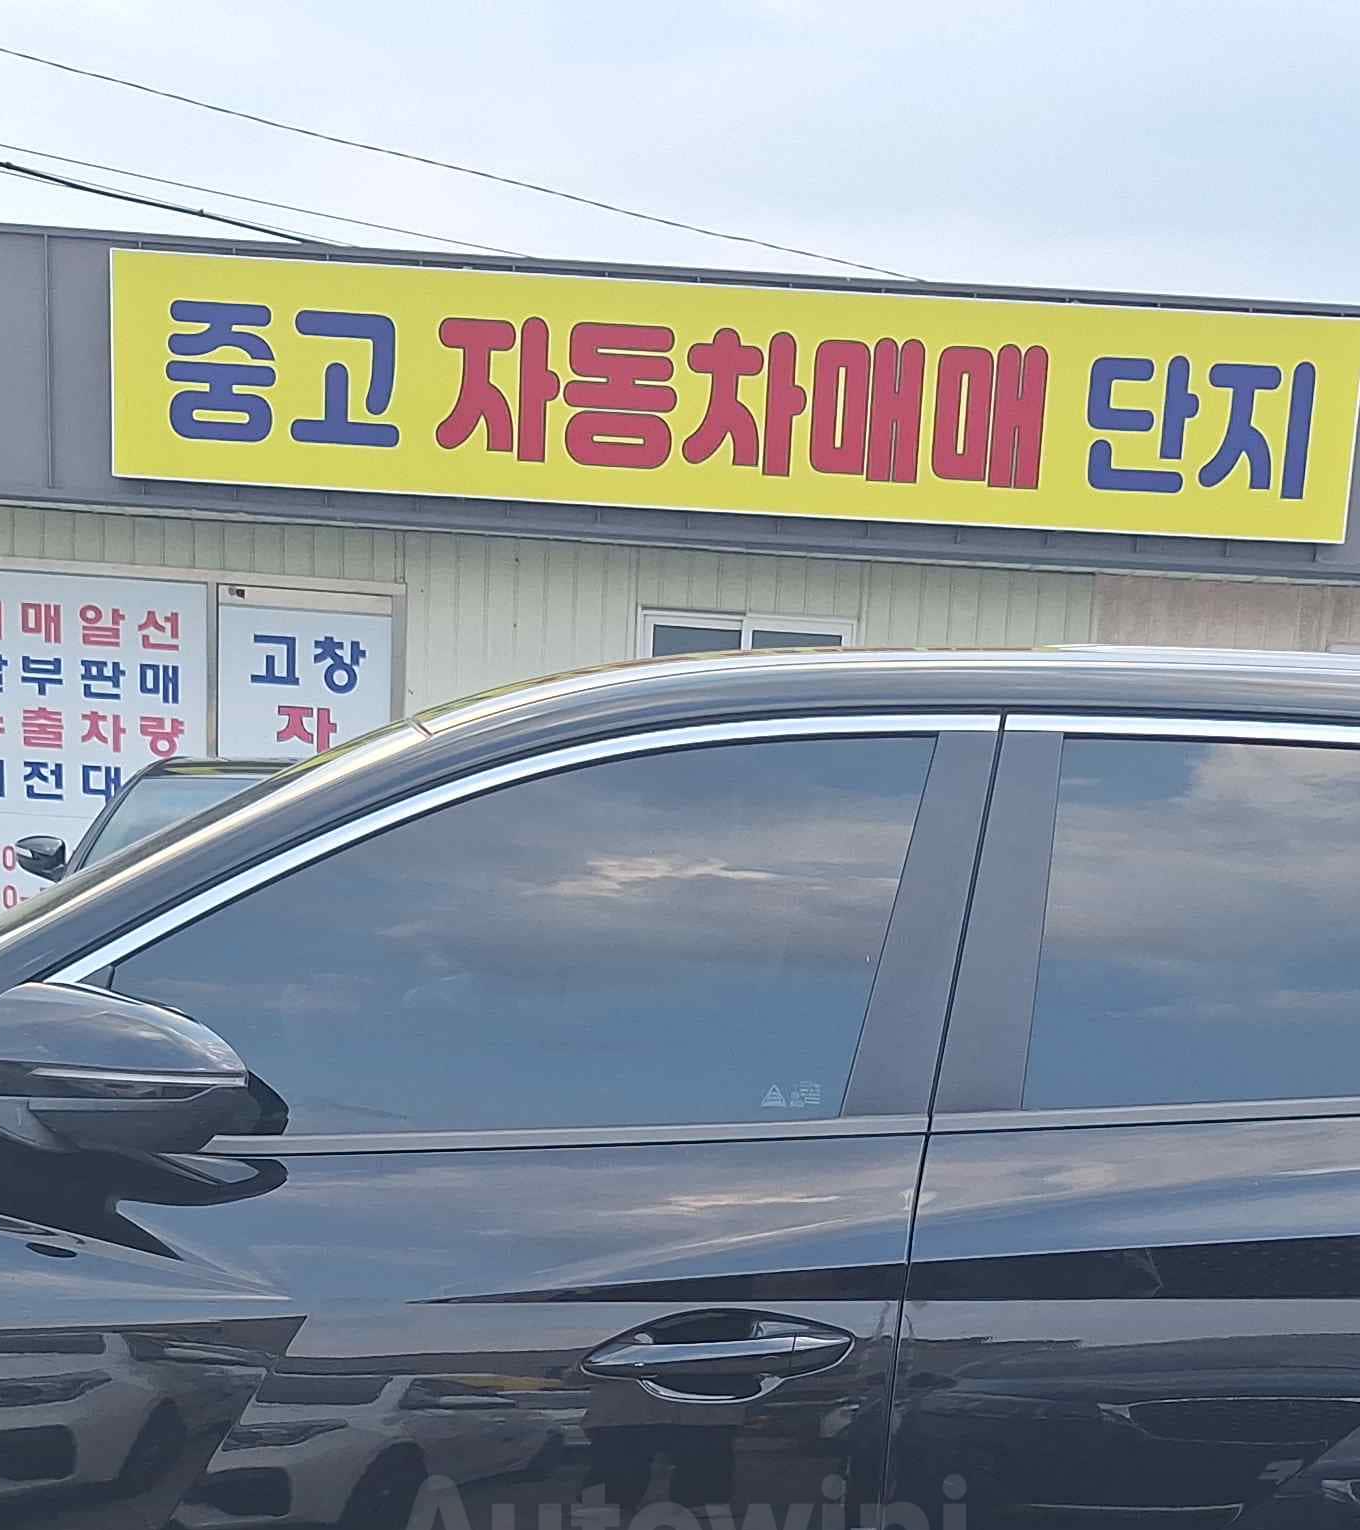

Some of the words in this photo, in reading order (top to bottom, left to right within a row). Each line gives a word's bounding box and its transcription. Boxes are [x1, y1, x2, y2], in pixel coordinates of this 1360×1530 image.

[166, 300, 400, 447] 중고
[436, 314, 1049, 490] 자동차매매
[1087, 355, 1317, 500] 단지
[250, 633, 367, 694] 고창
